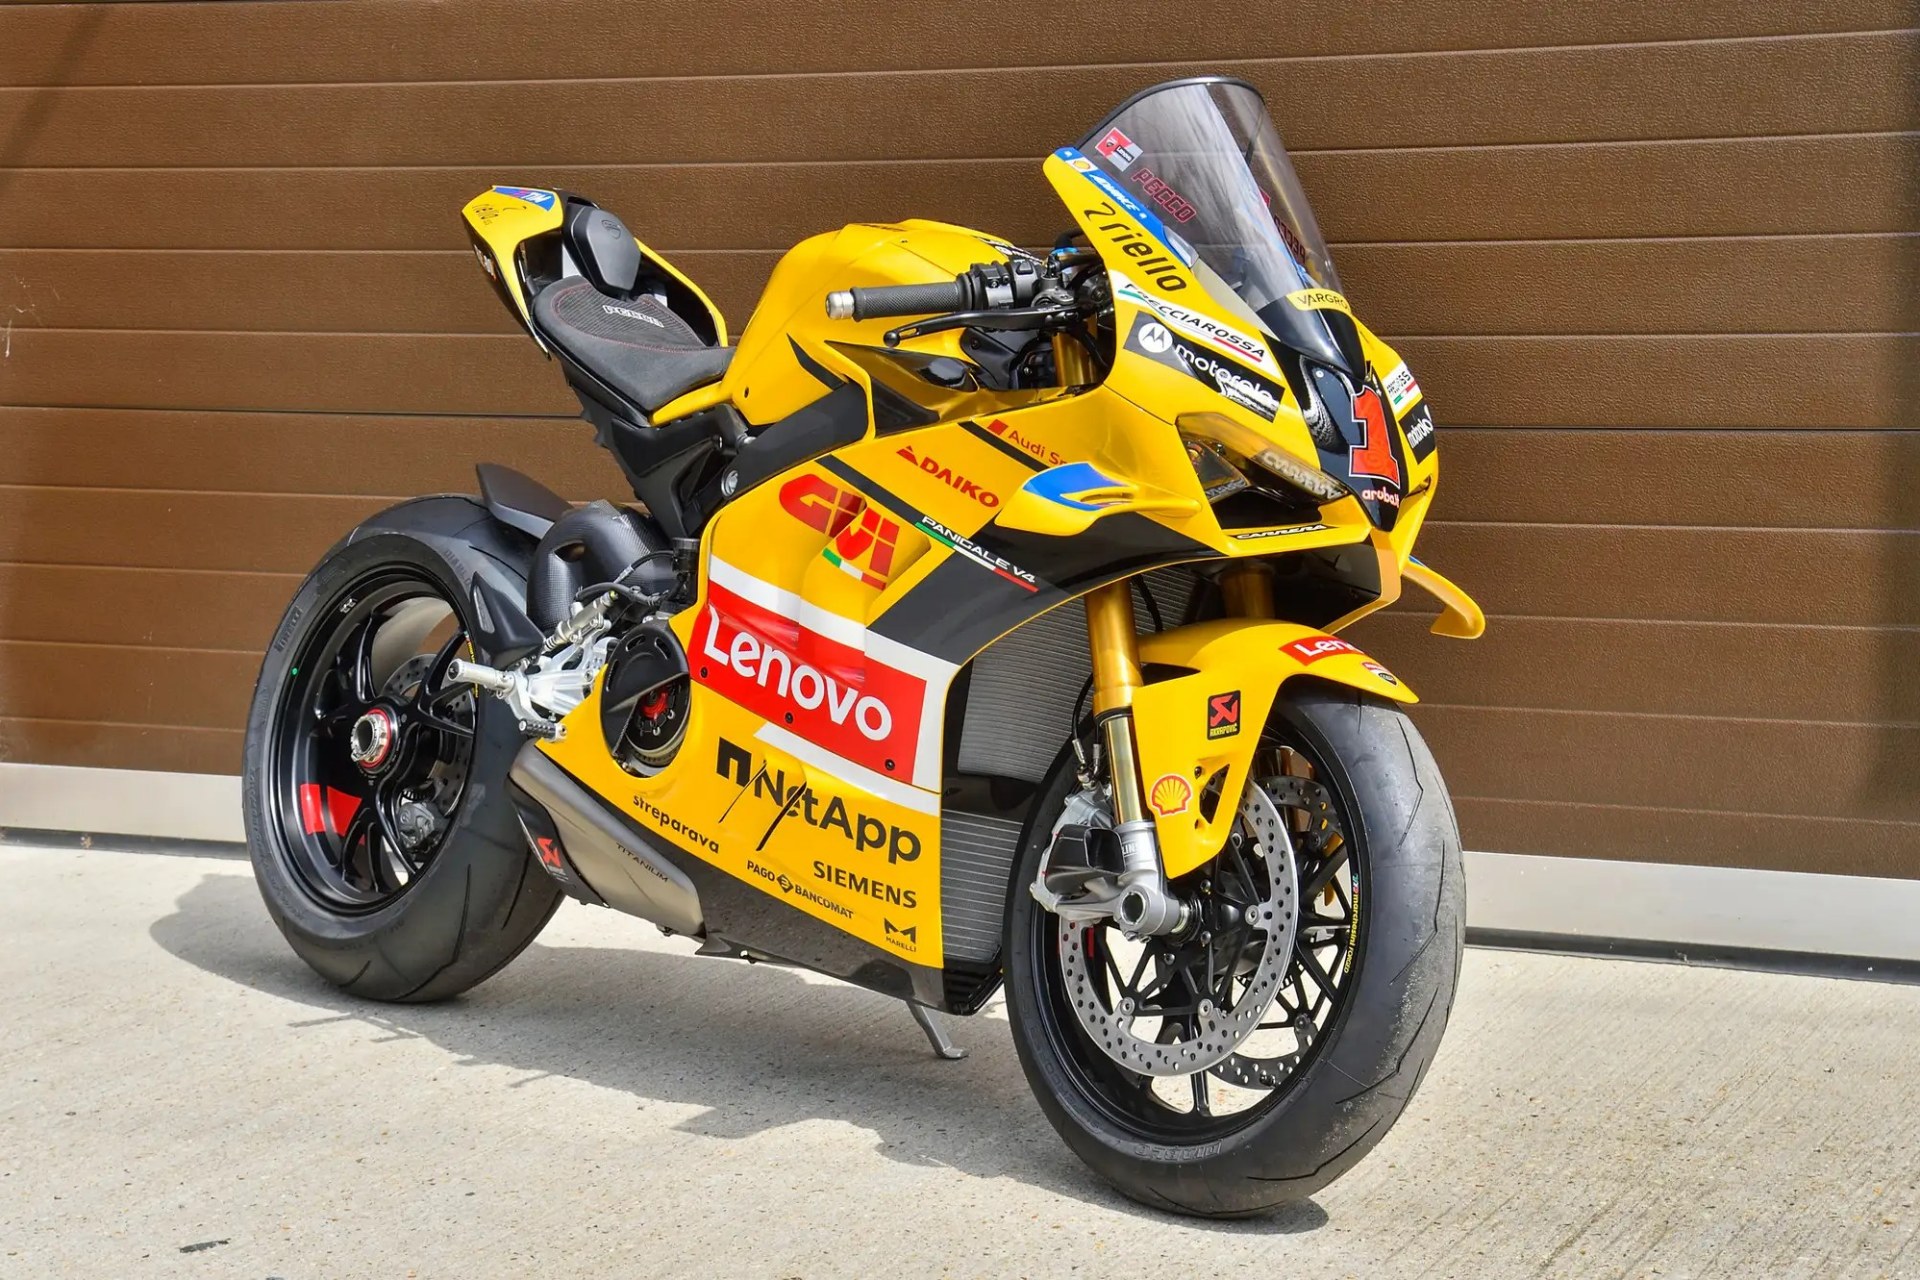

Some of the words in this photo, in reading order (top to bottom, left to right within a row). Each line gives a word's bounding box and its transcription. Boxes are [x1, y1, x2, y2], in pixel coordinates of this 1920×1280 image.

[1131, 168, 1197, 223] PECCO
[1098, 223, 1187, 292] riello
[1124, 283, 1265, 358] FRECCIAROSSA
[1008, 430, 1045, 458] Audi
[1351, 386, 1400, 487] 1
[920, 456, 1000, 508] DAIKO
[922, 516, 1010, 569] PANIGALE
[1013, 566, 1036, 583] V4
[1237, 524, 1327, 539] CARRERA
[703, 604, 892, 741] Lenovo
[1294, 640, 1363, 657] Len
[633, 795, 719, 854] streparava
[754, 769, 921, 865] NetApp
[616, 842, 669, 883] TITANIUM
[747, 860, 775, 882] PAGO
[795, 884, 854, 919] BANCOMAT
[813, 860, 917, 909] SIEMENS
[886, 936, 916, 952] MARELLI
